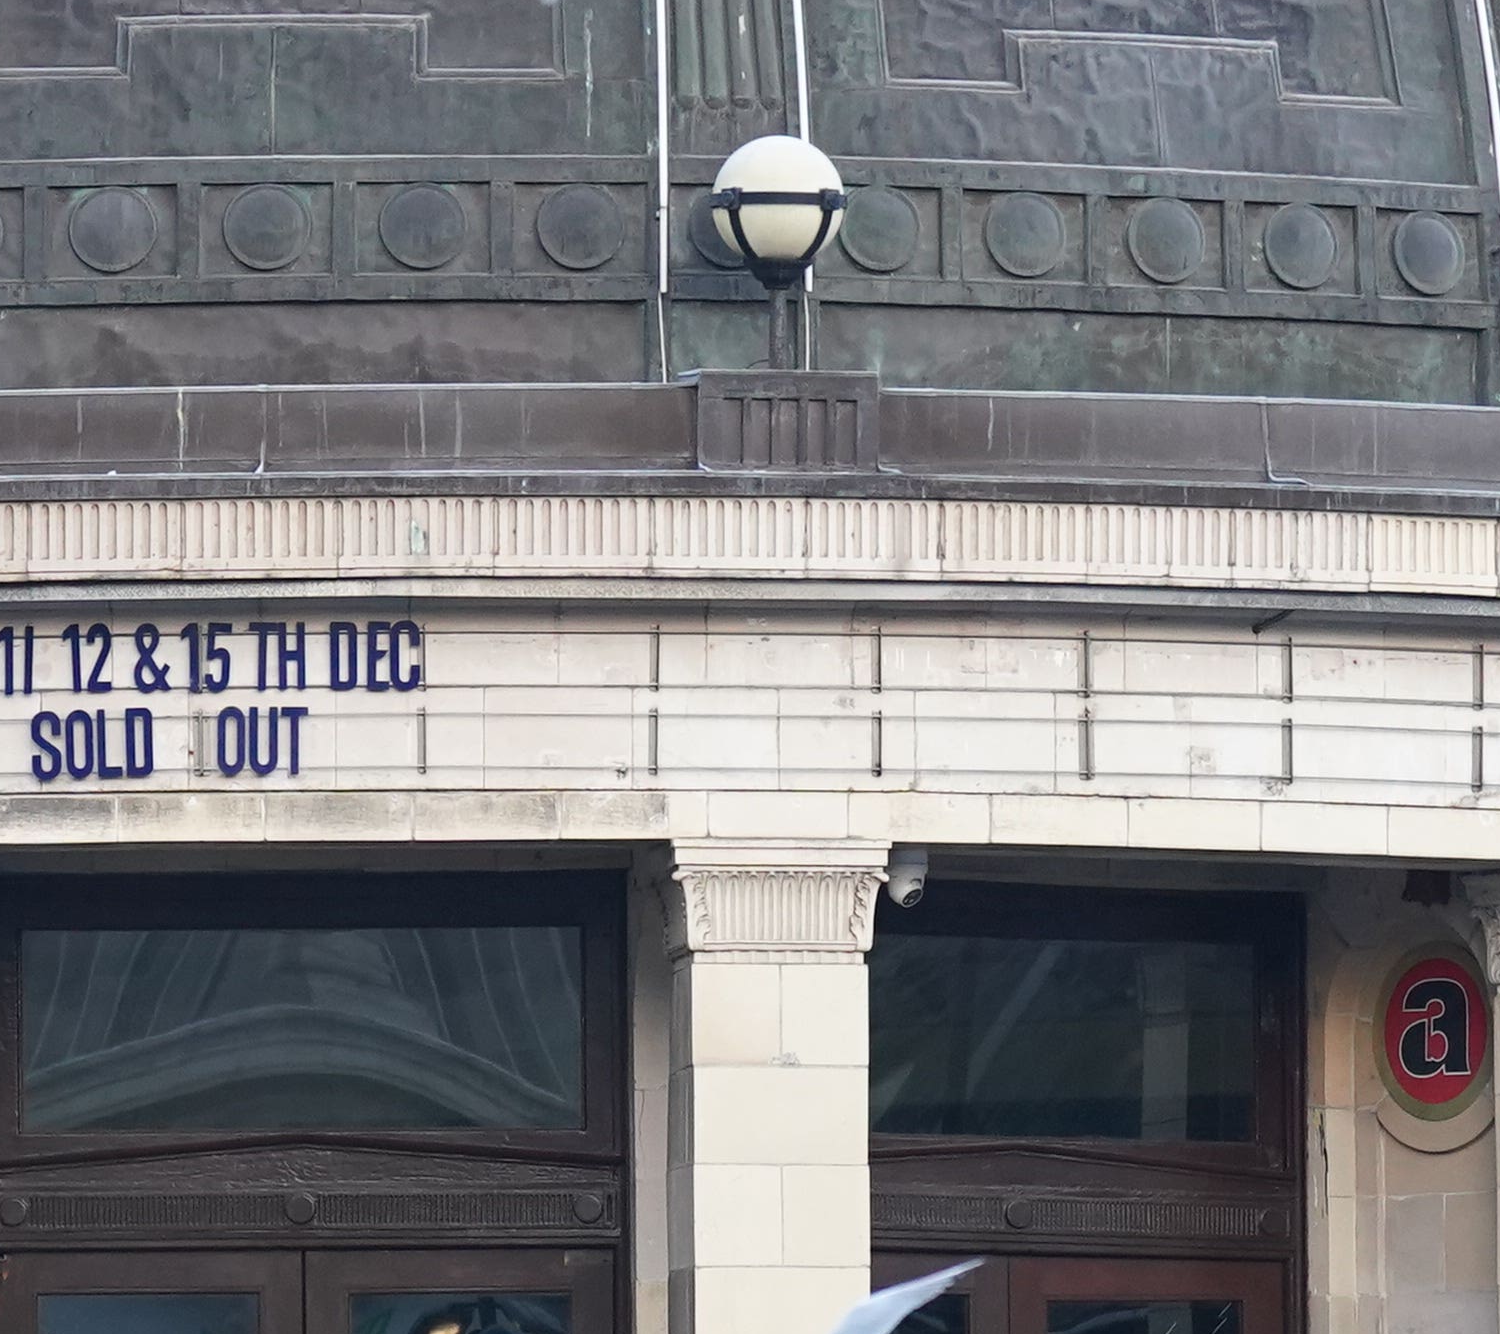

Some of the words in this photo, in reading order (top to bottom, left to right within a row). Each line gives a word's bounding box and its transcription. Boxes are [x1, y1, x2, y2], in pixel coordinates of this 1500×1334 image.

[62, 624, 113, 693] 12
[135, 623, 171, 693] &
[330, 620, 421, 692] DEC
[31, 707, 155, 784] SOLD
[217, 706, 309, 778] OUT
